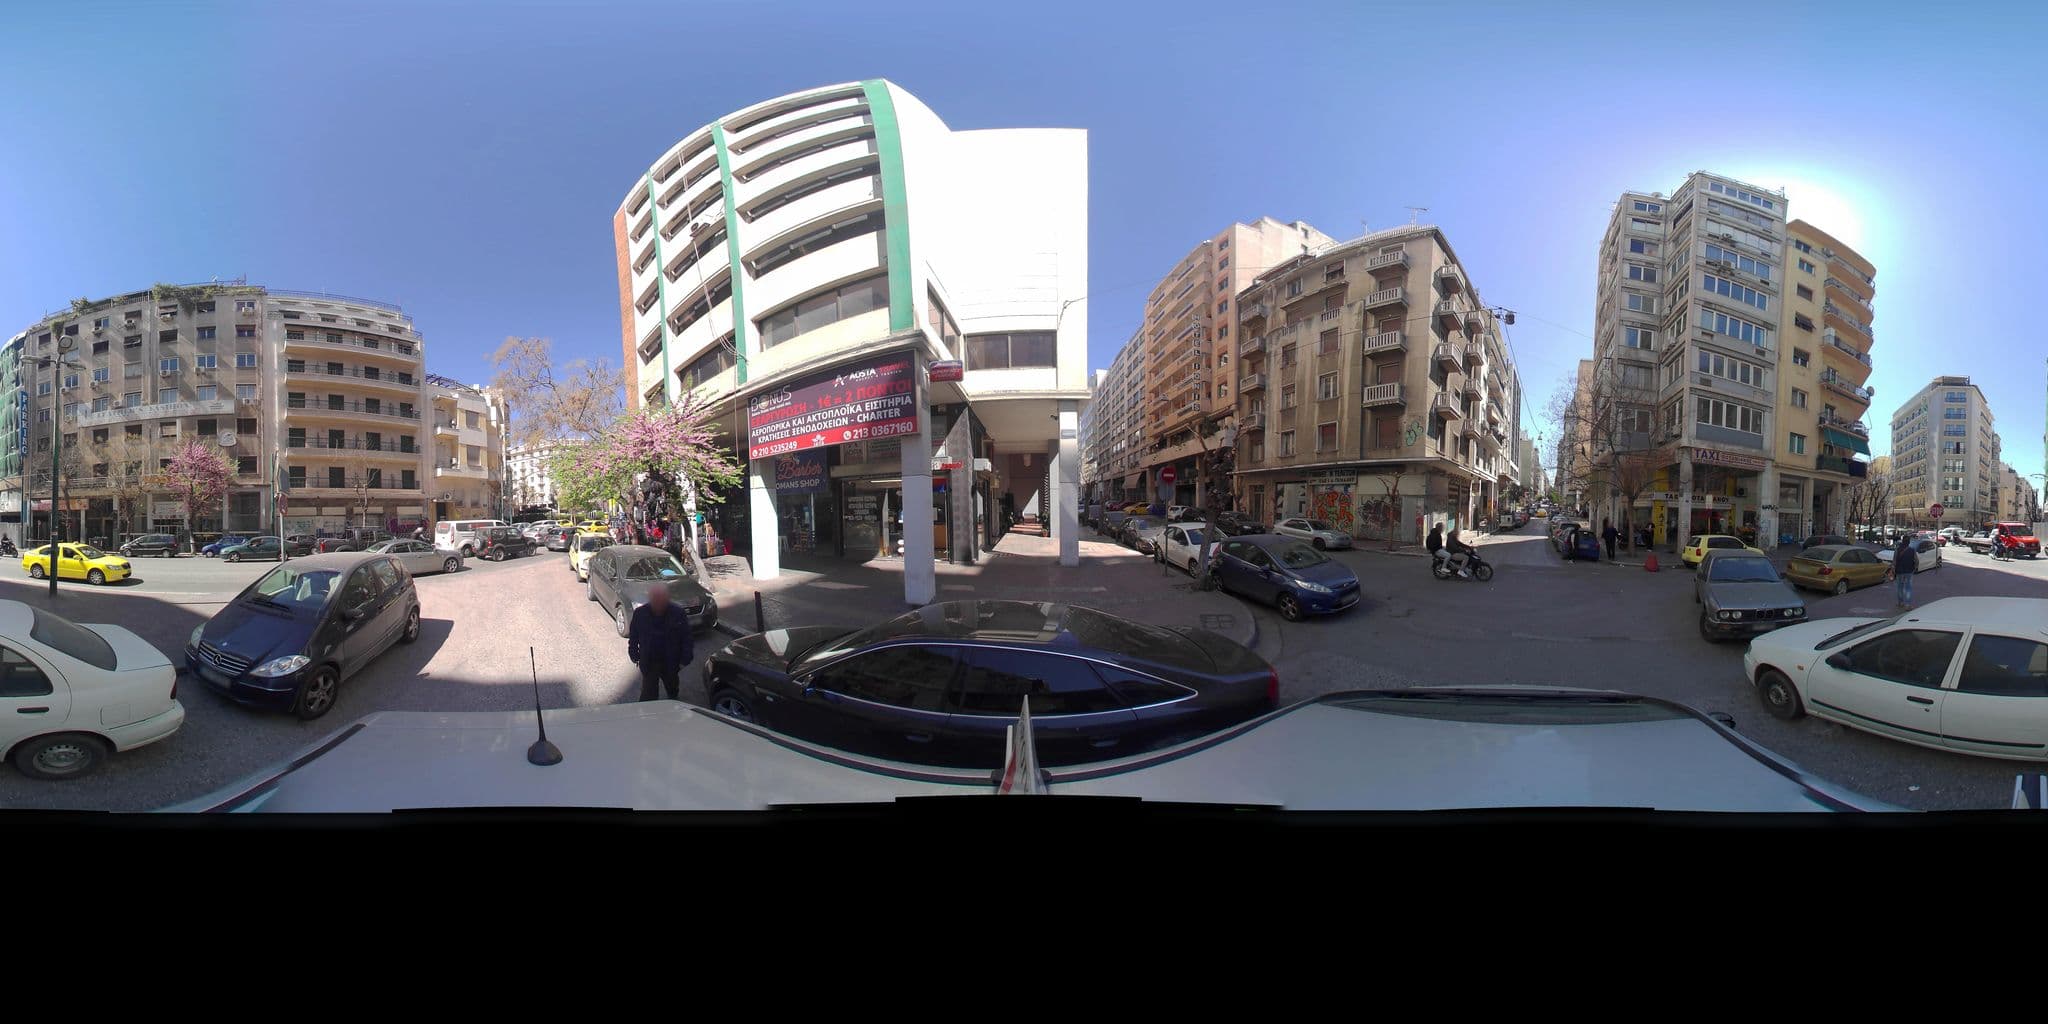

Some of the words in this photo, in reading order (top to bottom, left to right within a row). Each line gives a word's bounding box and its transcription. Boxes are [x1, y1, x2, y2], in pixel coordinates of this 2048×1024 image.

[750, 384, 792, 412] BONUS
[845, 389, 853, 403] 2
[856, 379, 912, 399] ΠΟΝΤΟΙ
[751, 421, 791, 438] ΑΕΡΟΠΟΡΙΚΑ
[792, 416, 805, 428] ΚΑΙ
[806, 402, 863, 425] ΑΚΤΟΠΛΟΪΚΑ
[865, 395, 912, 411] ΕΙΣΙΤΗΡΙΑ
[758, 429, 791, 444] ΚΡΑΤΗΣΕΙΣ
[792, 416, 849, 436] ΞΕΝΟΔΟΧΕΙΩΝ
[856, 407, 901, 424] CHARTER
[853, 427, 869, 440] 213
[871, 421, 913, 437] 0367160
[758, 445, 769, 457] 210
[770, 440, 798, 455] 5235249
[1695, 449, 1721, 461] TAXI
[777, 459, 823, 481] Barber
[799, 478, 820, 488] SHOP
